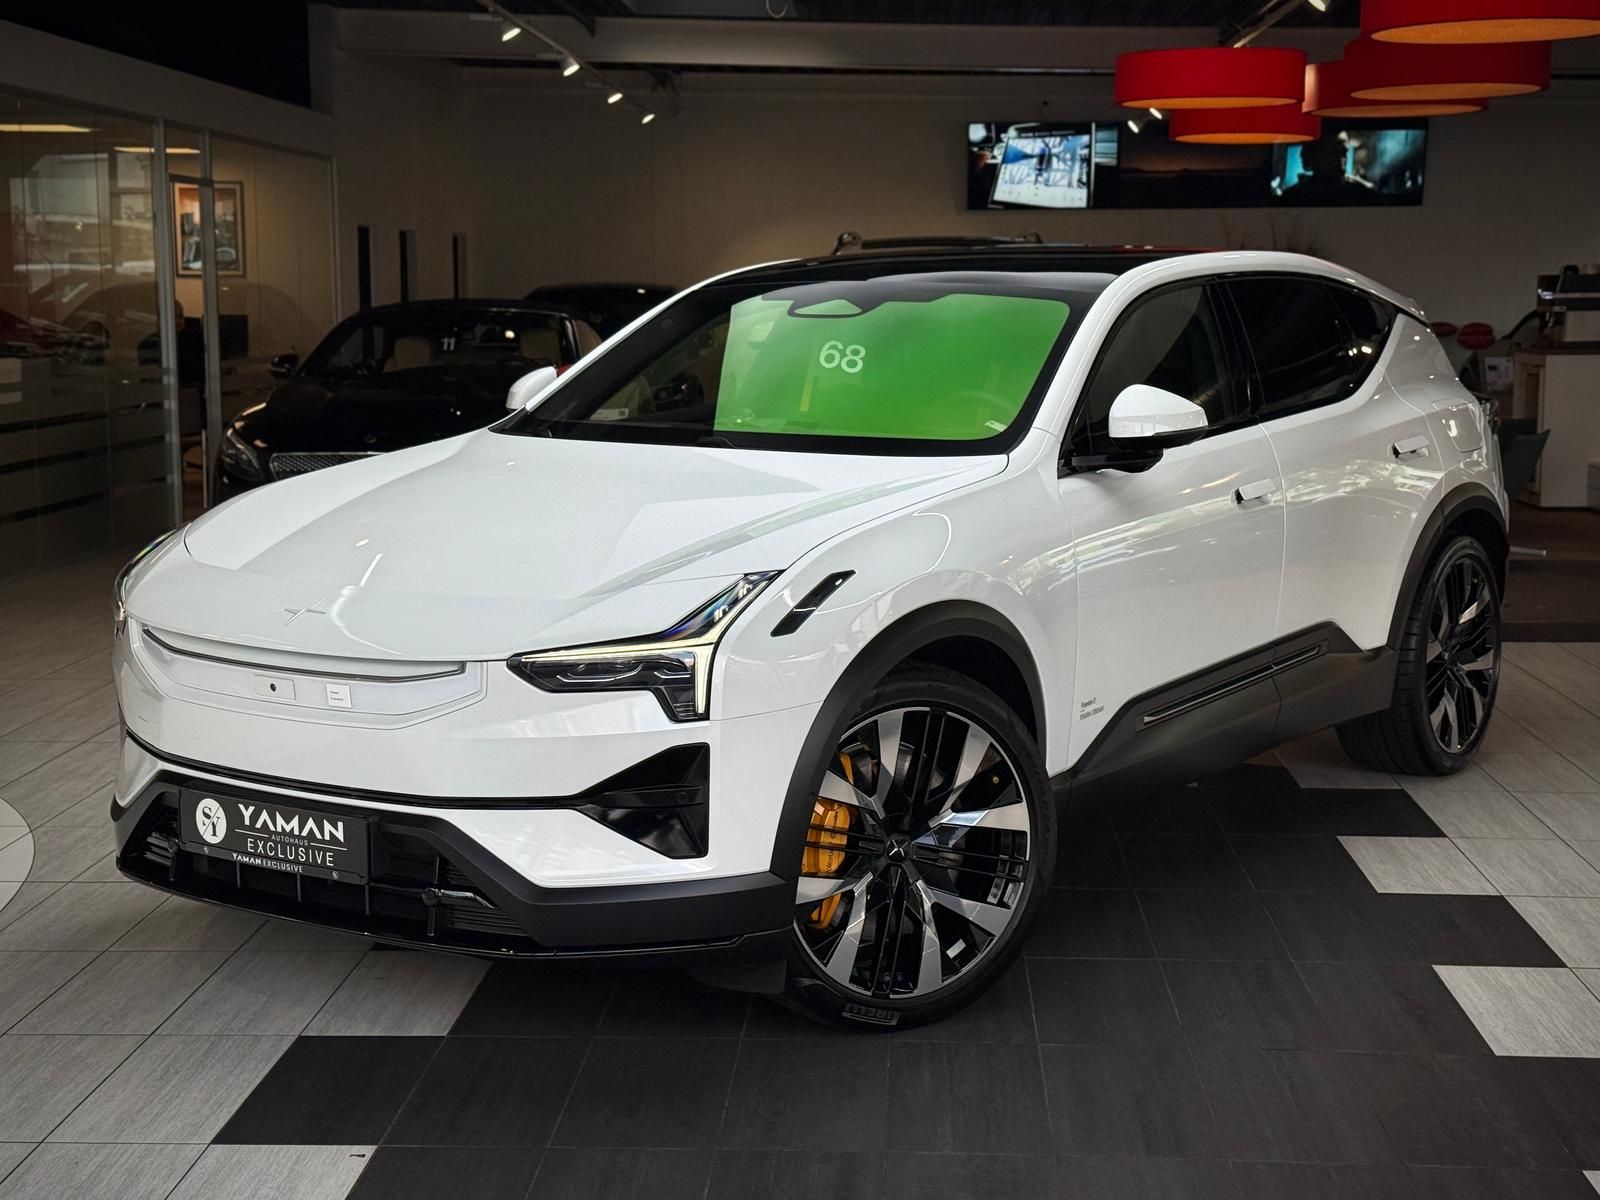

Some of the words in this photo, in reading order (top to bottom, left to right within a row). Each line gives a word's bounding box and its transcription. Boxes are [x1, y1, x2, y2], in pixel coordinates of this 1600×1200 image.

[819, 340, 866, 374] 68
[237, 803, 345, 843] YAMAN
[247, 838, 335, 867] EXCLUSIVE
[271, 834, 309, 846] AUTOHAUS
[232, 852, 262, 865] YAMAN
[262, 859, 304, 873] EXCLUSIVE
